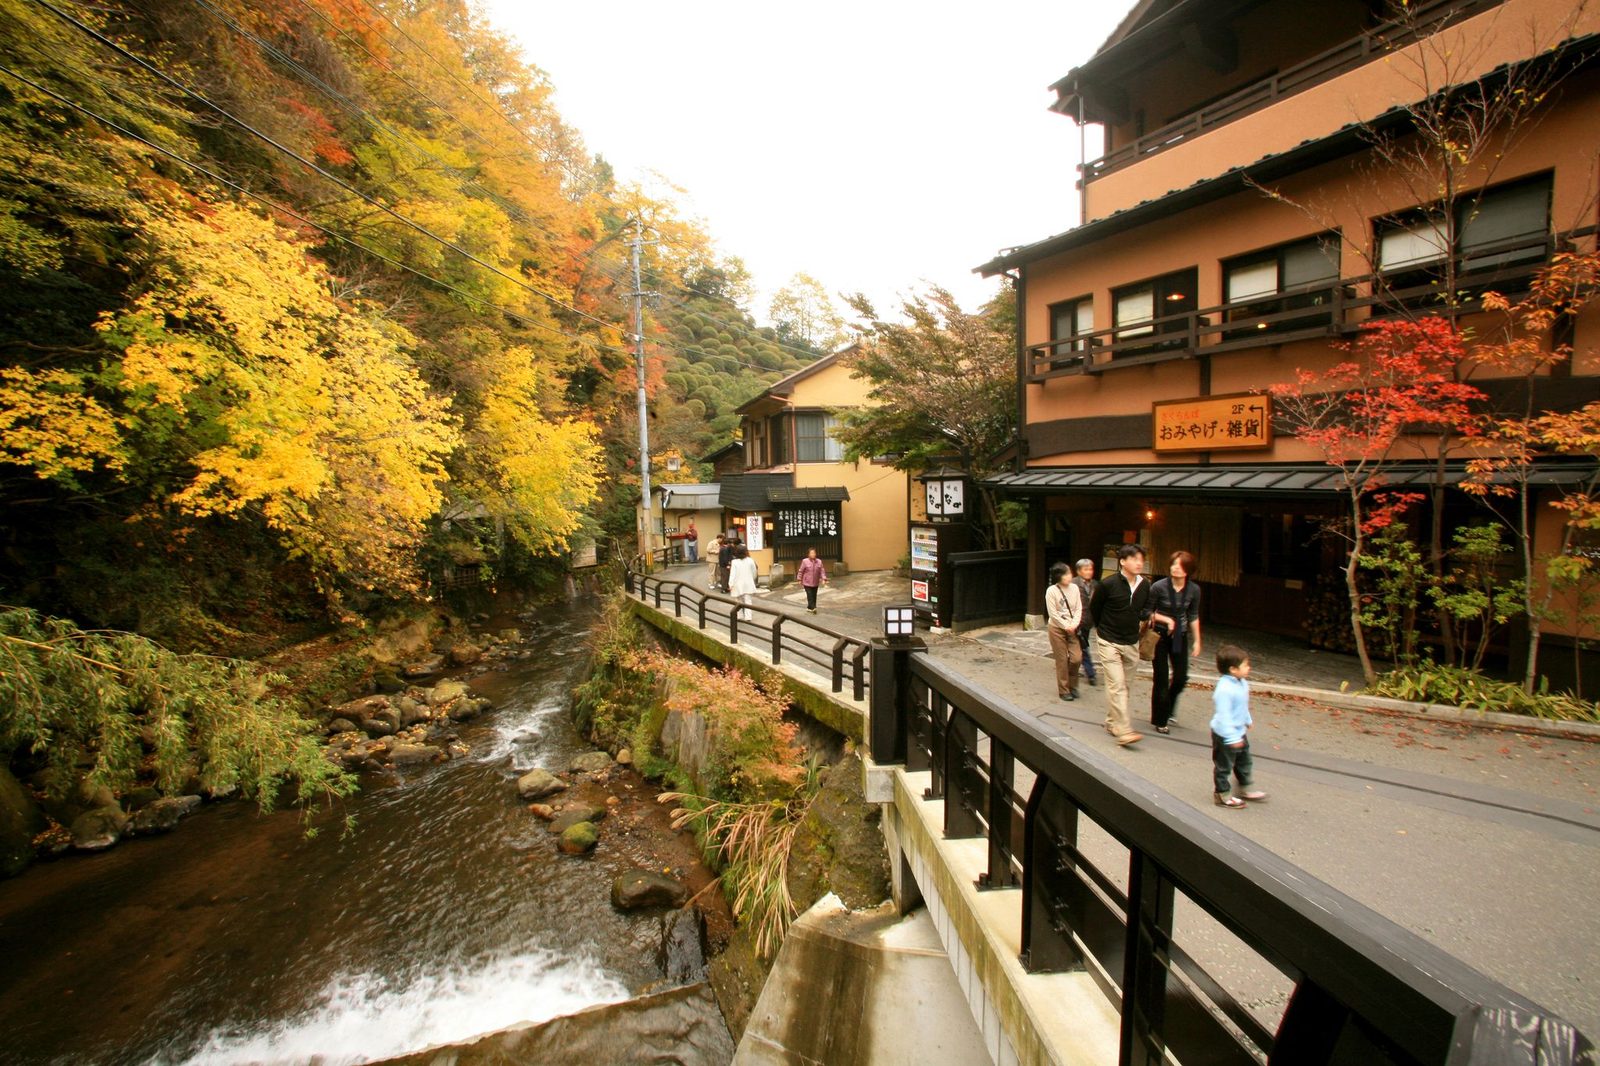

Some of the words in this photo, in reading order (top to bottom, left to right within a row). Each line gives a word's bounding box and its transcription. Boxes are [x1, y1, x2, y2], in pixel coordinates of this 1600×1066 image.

[1231, 404, 1245, 415] 2F
[1160, 419, 1259, 440] おみやげ・雑貨
